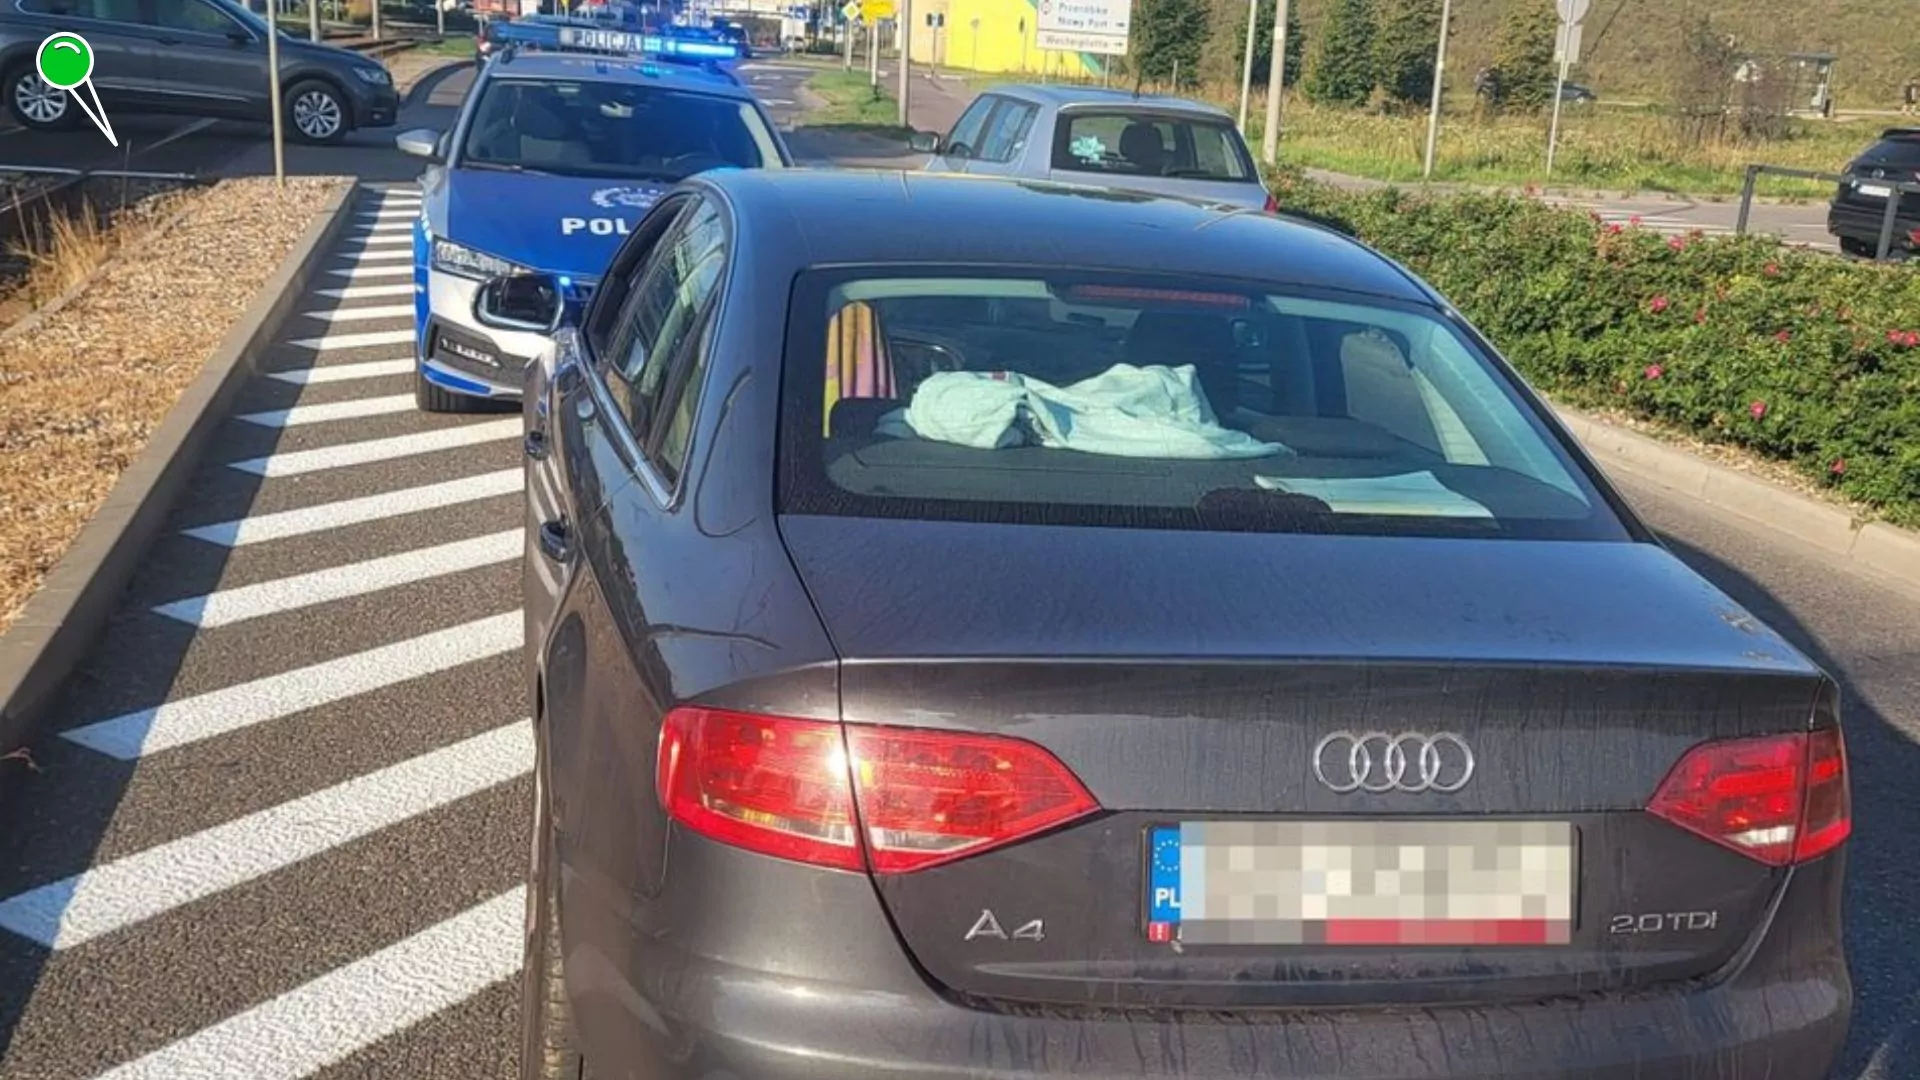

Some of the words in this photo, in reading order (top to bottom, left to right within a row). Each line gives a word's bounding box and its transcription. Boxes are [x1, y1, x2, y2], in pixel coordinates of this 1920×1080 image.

[573, 29, 637, 51] POLICJA
[562, 217, 631, 236] POL
[1154, 887, 1181, 908] PL
[964, 908, 1045, 941] A4
[1666, 910, 1718, 931] TDI
